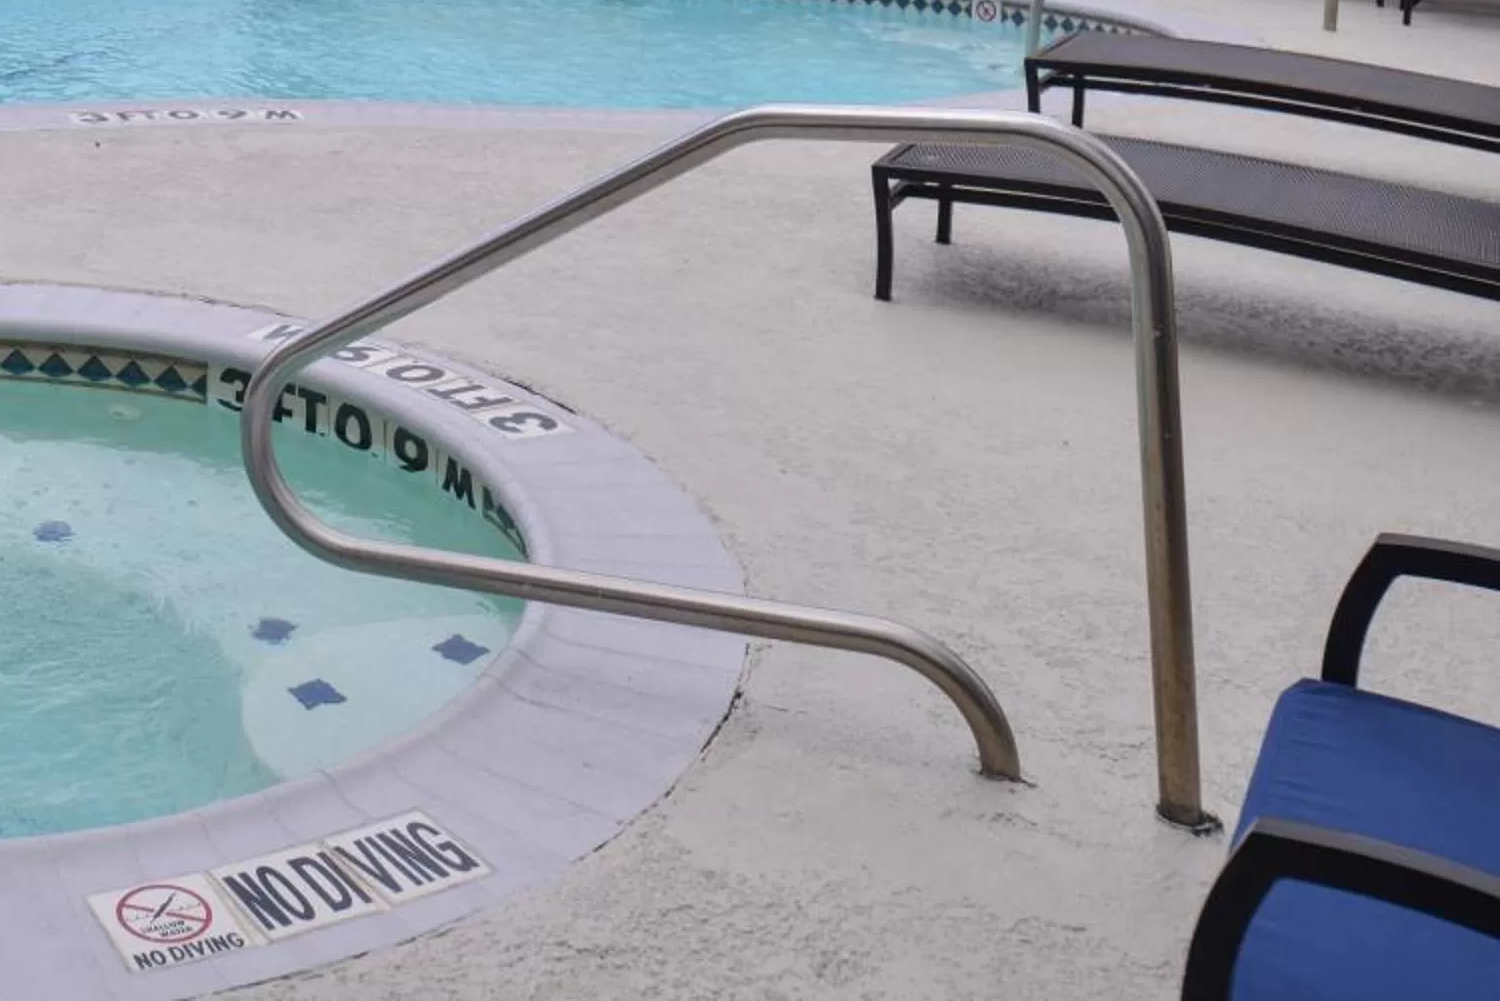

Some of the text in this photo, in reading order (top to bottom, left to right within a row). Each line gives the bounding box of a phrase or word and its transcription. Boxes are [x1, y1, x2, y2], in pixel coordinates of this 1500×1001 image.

[218, 367, 253, 412] 3
[442, 455, 476, 510] M
[489, 411, 558, 433] 3
[222, 821, 480, 931] NO DIVING
[133, 931, 245, 970] NO DIVING
